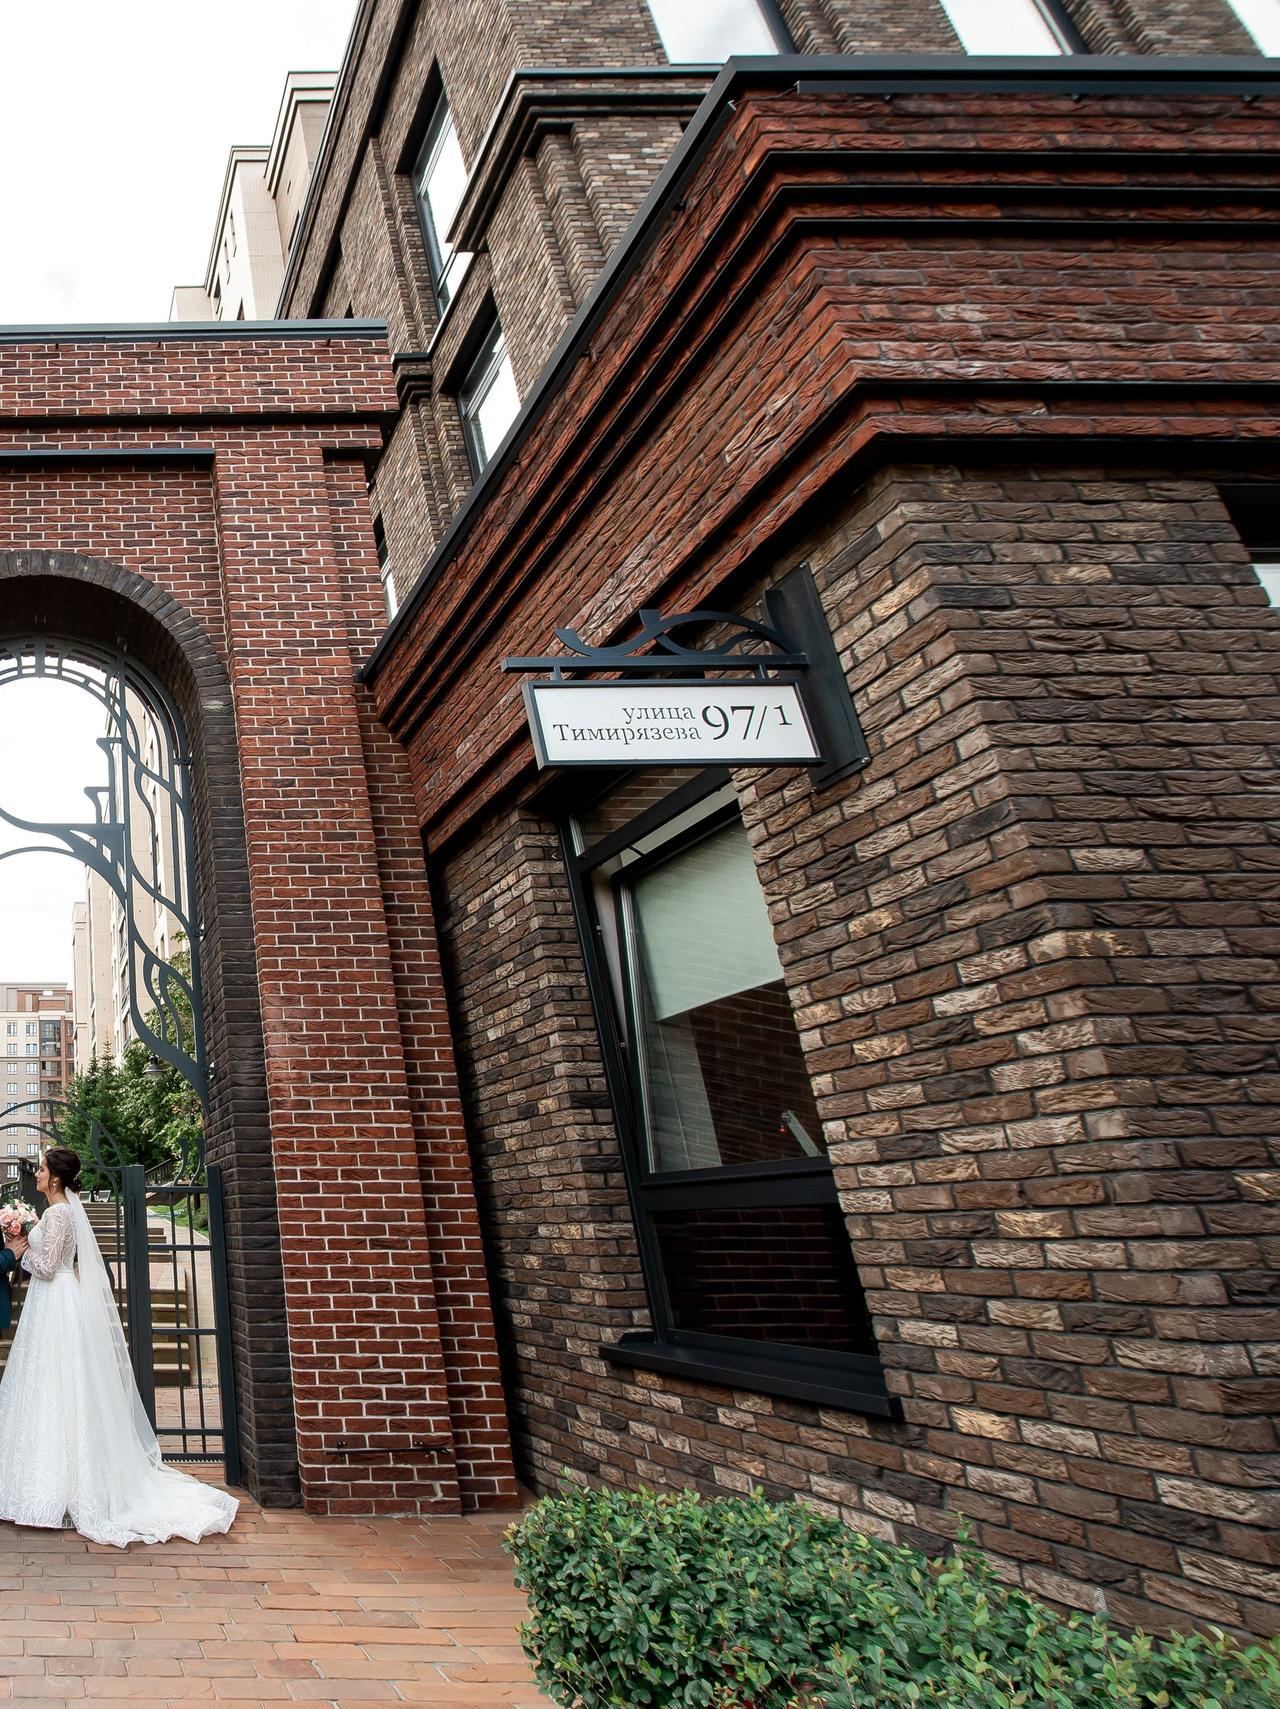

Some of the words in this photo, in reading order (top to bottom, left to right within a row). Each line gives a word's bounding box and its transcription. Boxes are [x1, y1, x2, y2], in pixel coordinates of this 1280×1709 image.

[621, 705, 696, 725] улица
[701, 704, 793, 741] 97/1
[552, 723, 702, 745] Тимирязева
